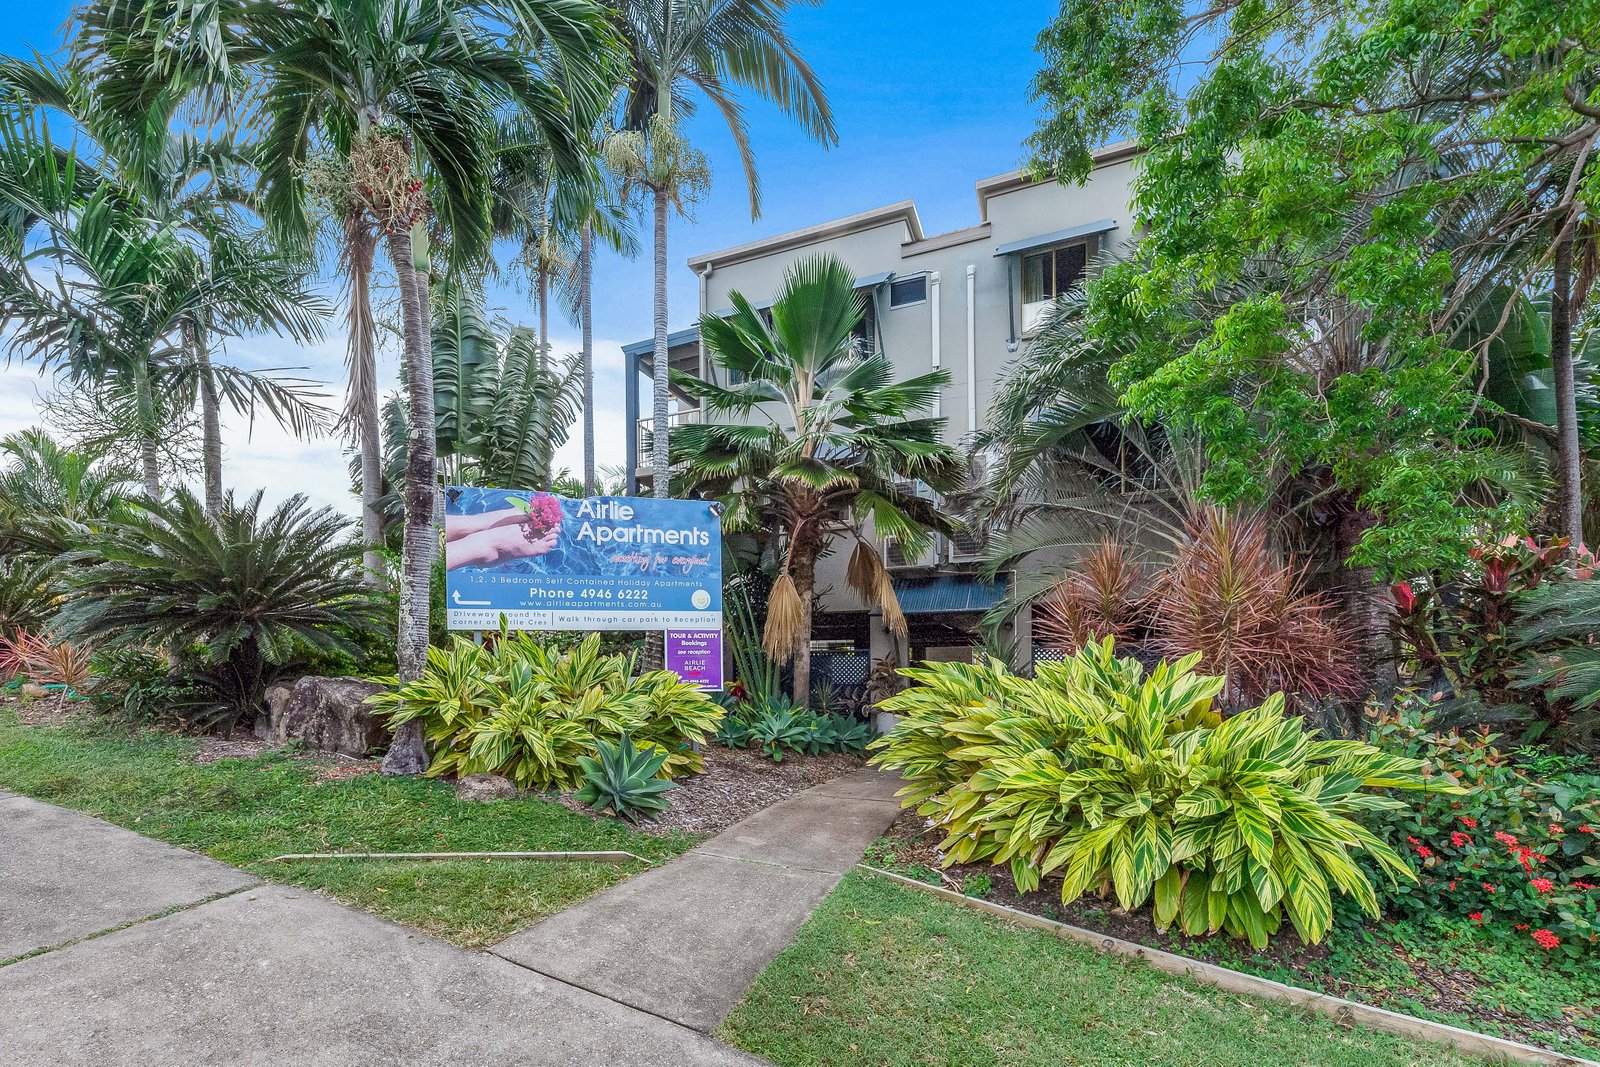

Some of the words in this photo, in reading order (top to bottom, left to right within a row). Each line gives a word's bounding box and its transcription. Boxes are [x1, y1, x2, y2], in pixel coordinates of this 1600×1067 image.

[576, 500, 635, 520] Airlie
[576, 521, 710, 546] Apartments
[653, 552, 668, 570] for
[566, 578, 615, 586] Contained
[530, 588, 575, 598] Phone
[580, 589, 612, 599] 4946
[617, 590, 649, 600] 6222
